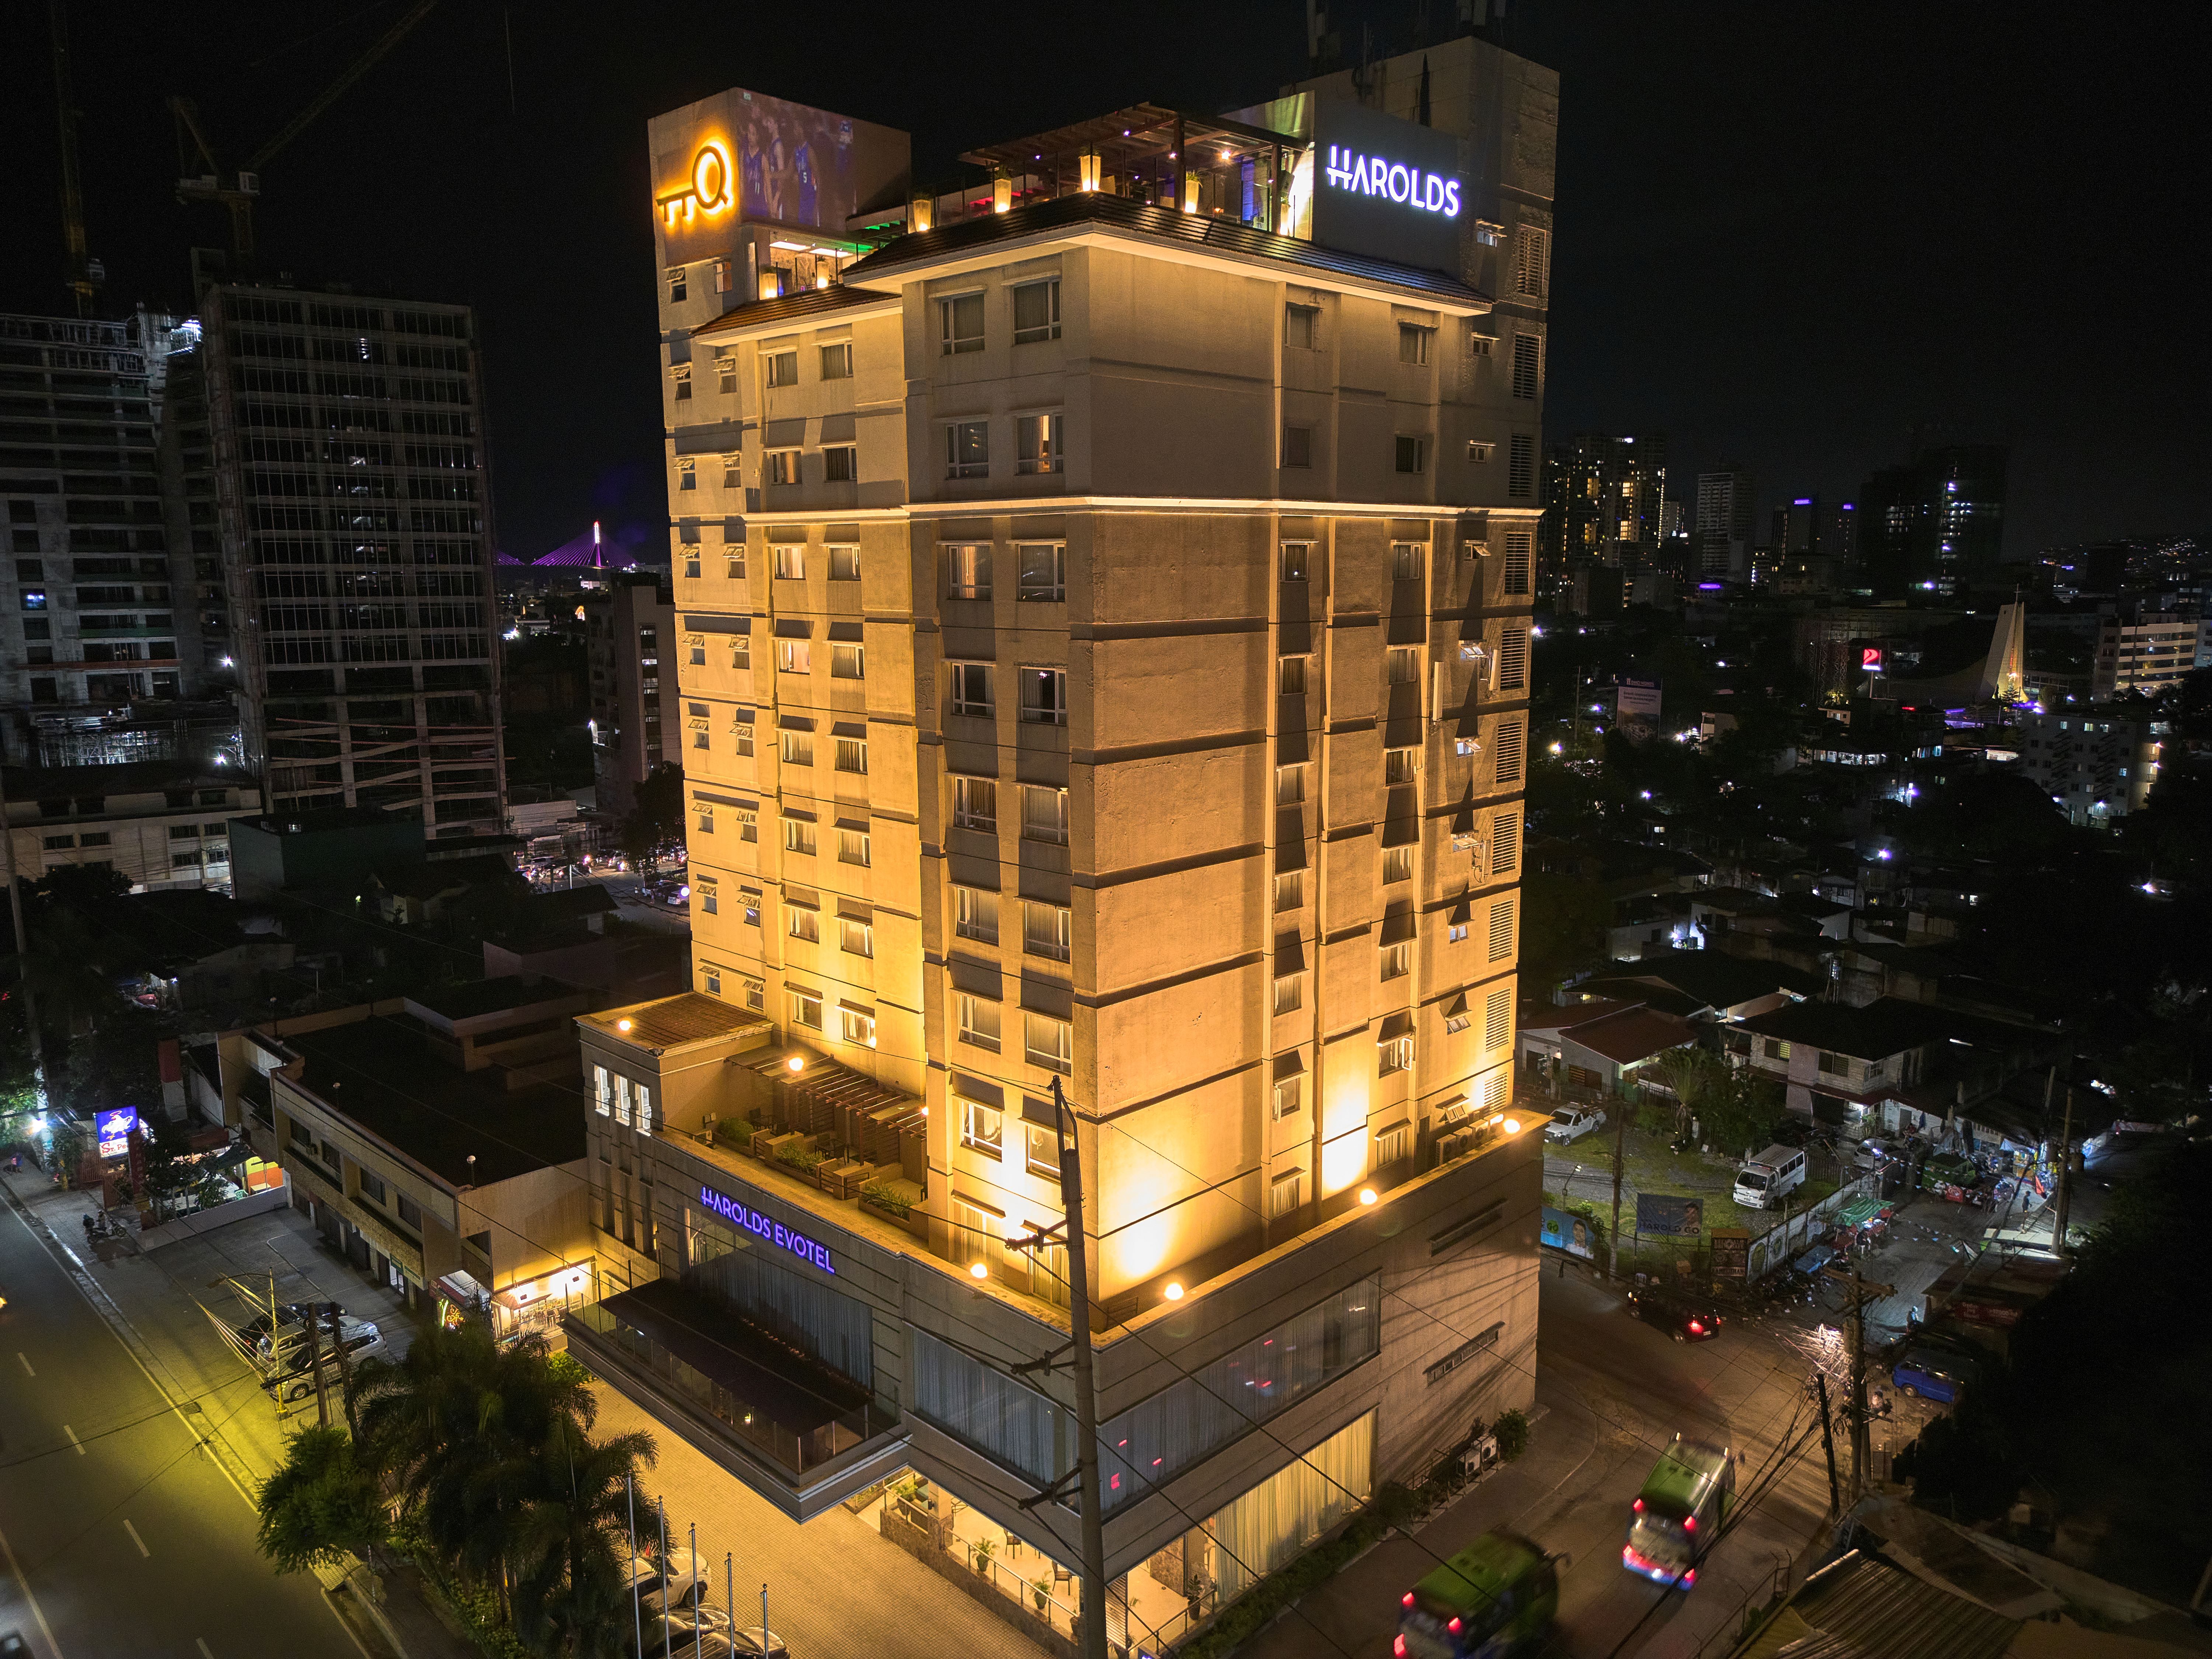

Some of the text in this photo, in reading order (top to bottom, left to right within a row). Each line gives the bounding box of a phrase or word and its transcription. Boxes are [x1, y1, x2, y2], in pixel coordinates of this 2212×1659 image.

[1326, 145, 1461, 217] HAROLDS
[701, 1186, 835, 1273] HAROLDS EVOTEL
[1547, 1222, 1559, 1231] GO
[1639, 1221, 1681, 1232] HAROLD
